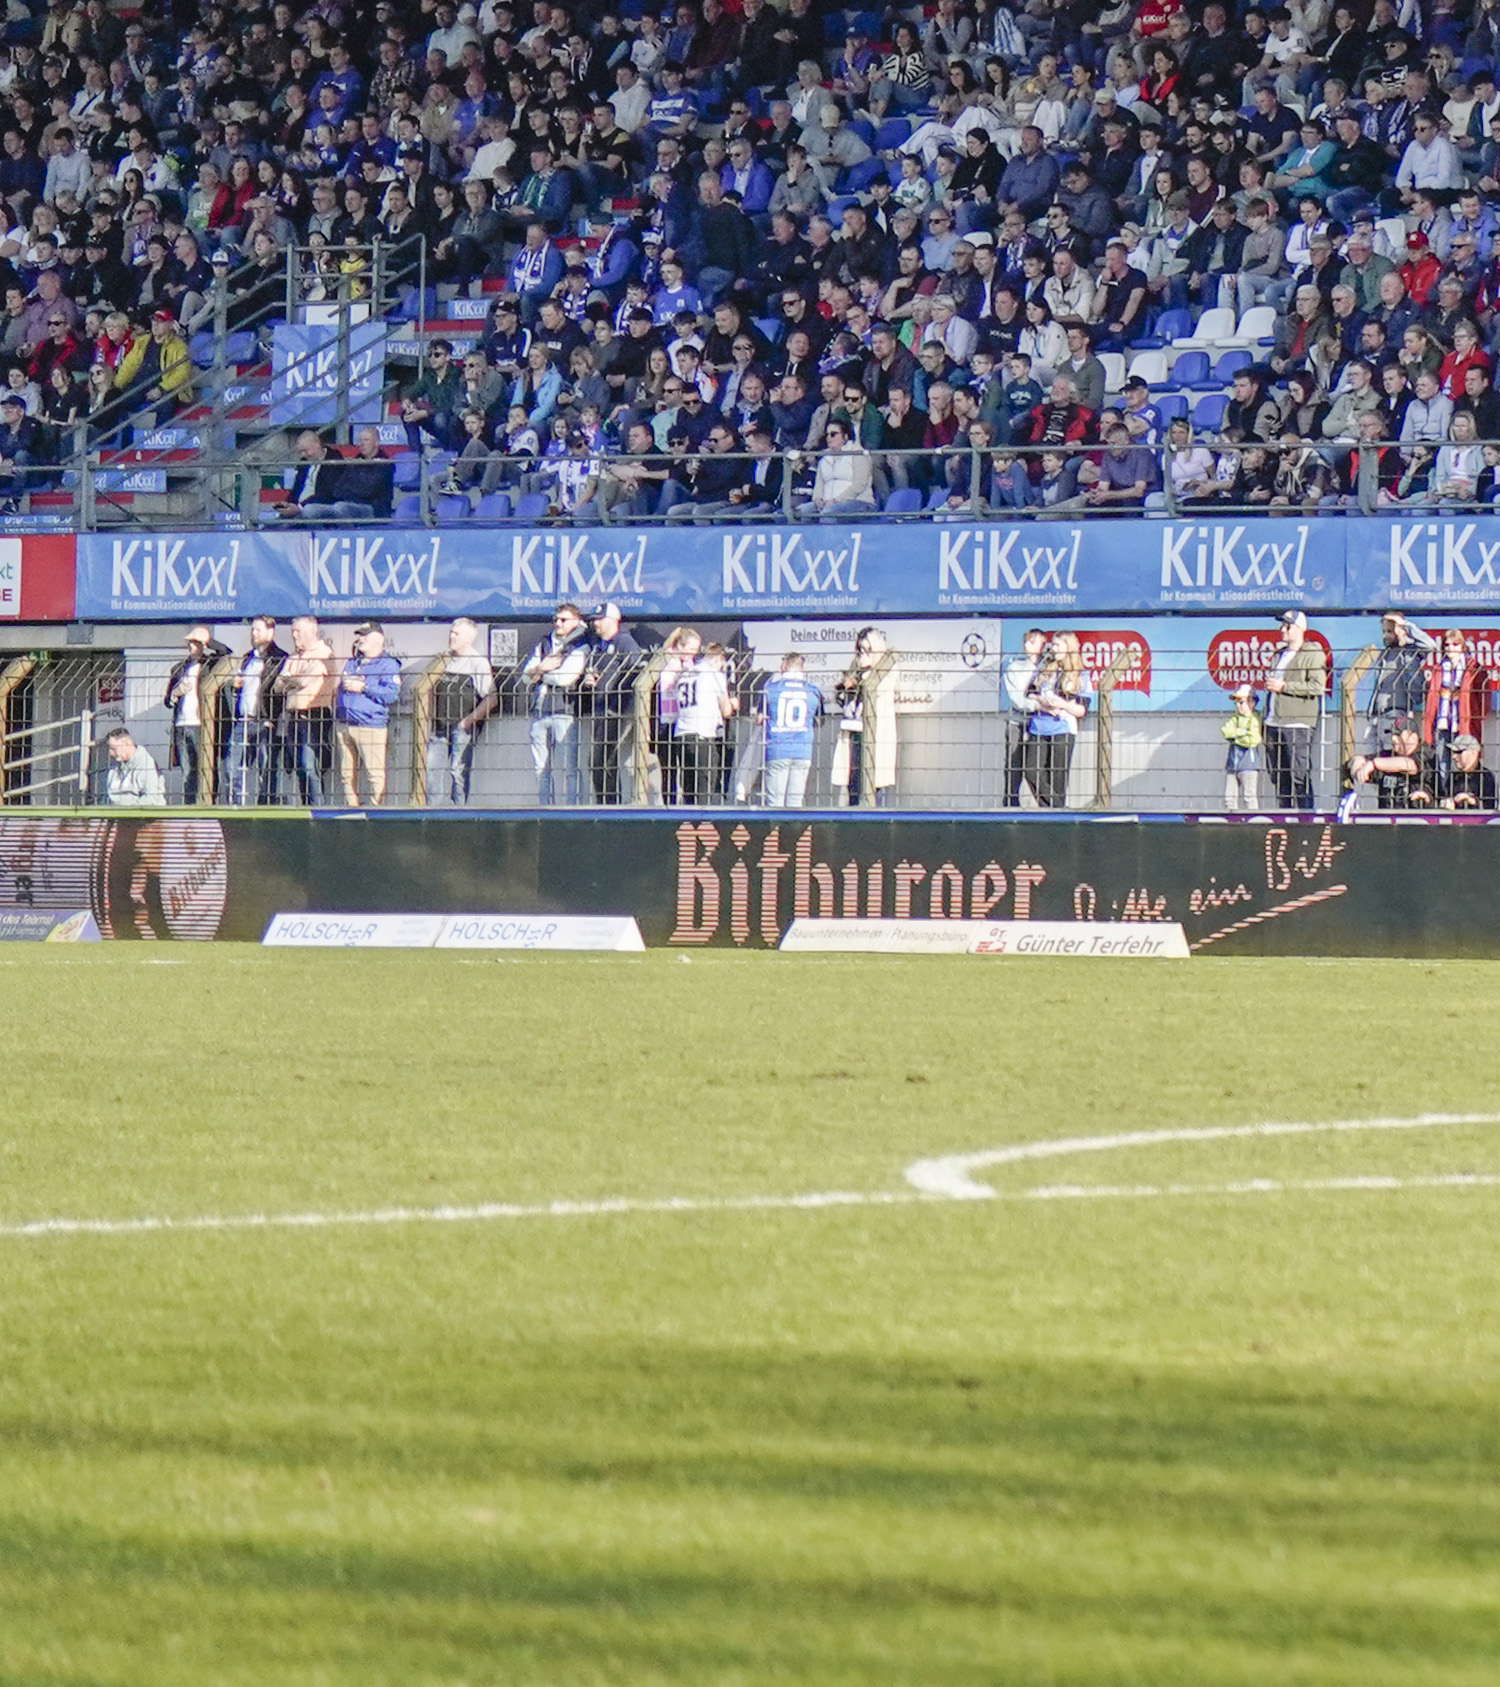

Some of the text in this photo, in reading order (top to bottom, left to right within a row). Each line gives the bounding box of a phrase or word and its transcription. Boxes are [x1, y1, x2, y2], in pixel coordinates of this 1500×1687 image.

[112, 539, 240, 596] KiKxxl
[309, 537, 440, 595] KiKxxl
[511, 535, 647, 594] KiKxxl
[723, 532, 862, 593] KiKxxl
[939, 529, 1082, 590] KiKxxl
[1161, 525, 1309, 587] KiKxxl
[677, 681, 698, 708] 31
[777, 698, 809, 728] 10
[1264, 825, 1347, 891] Bit
[1016, 932, 1165, 957] Günter Terfehr
